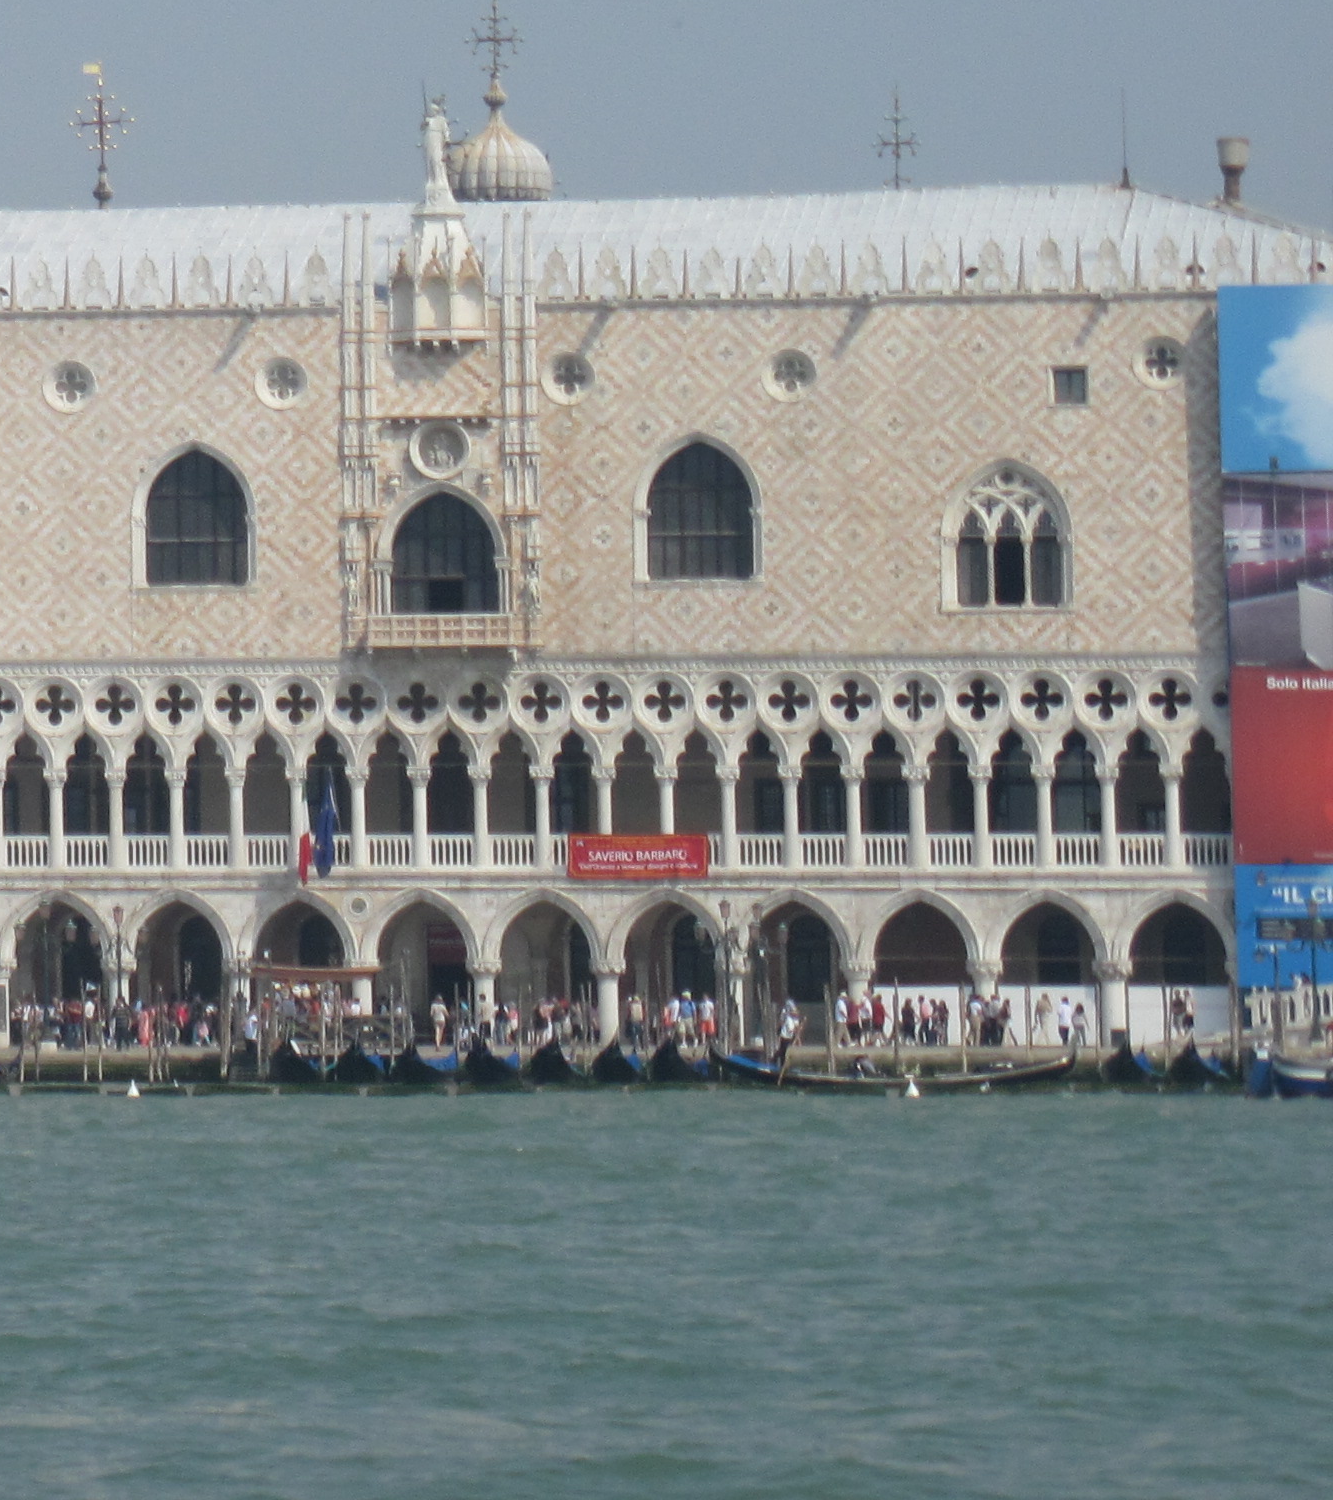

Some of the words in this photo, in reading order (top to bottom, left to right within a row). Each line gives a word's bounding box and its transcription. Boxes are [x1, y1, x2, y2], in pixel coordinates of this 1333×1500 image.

[1266, 676, 1298, 690] Solo
[588, 850, 633, 862] SAVERIO
[636, 849, 687, 861] BARBARO
